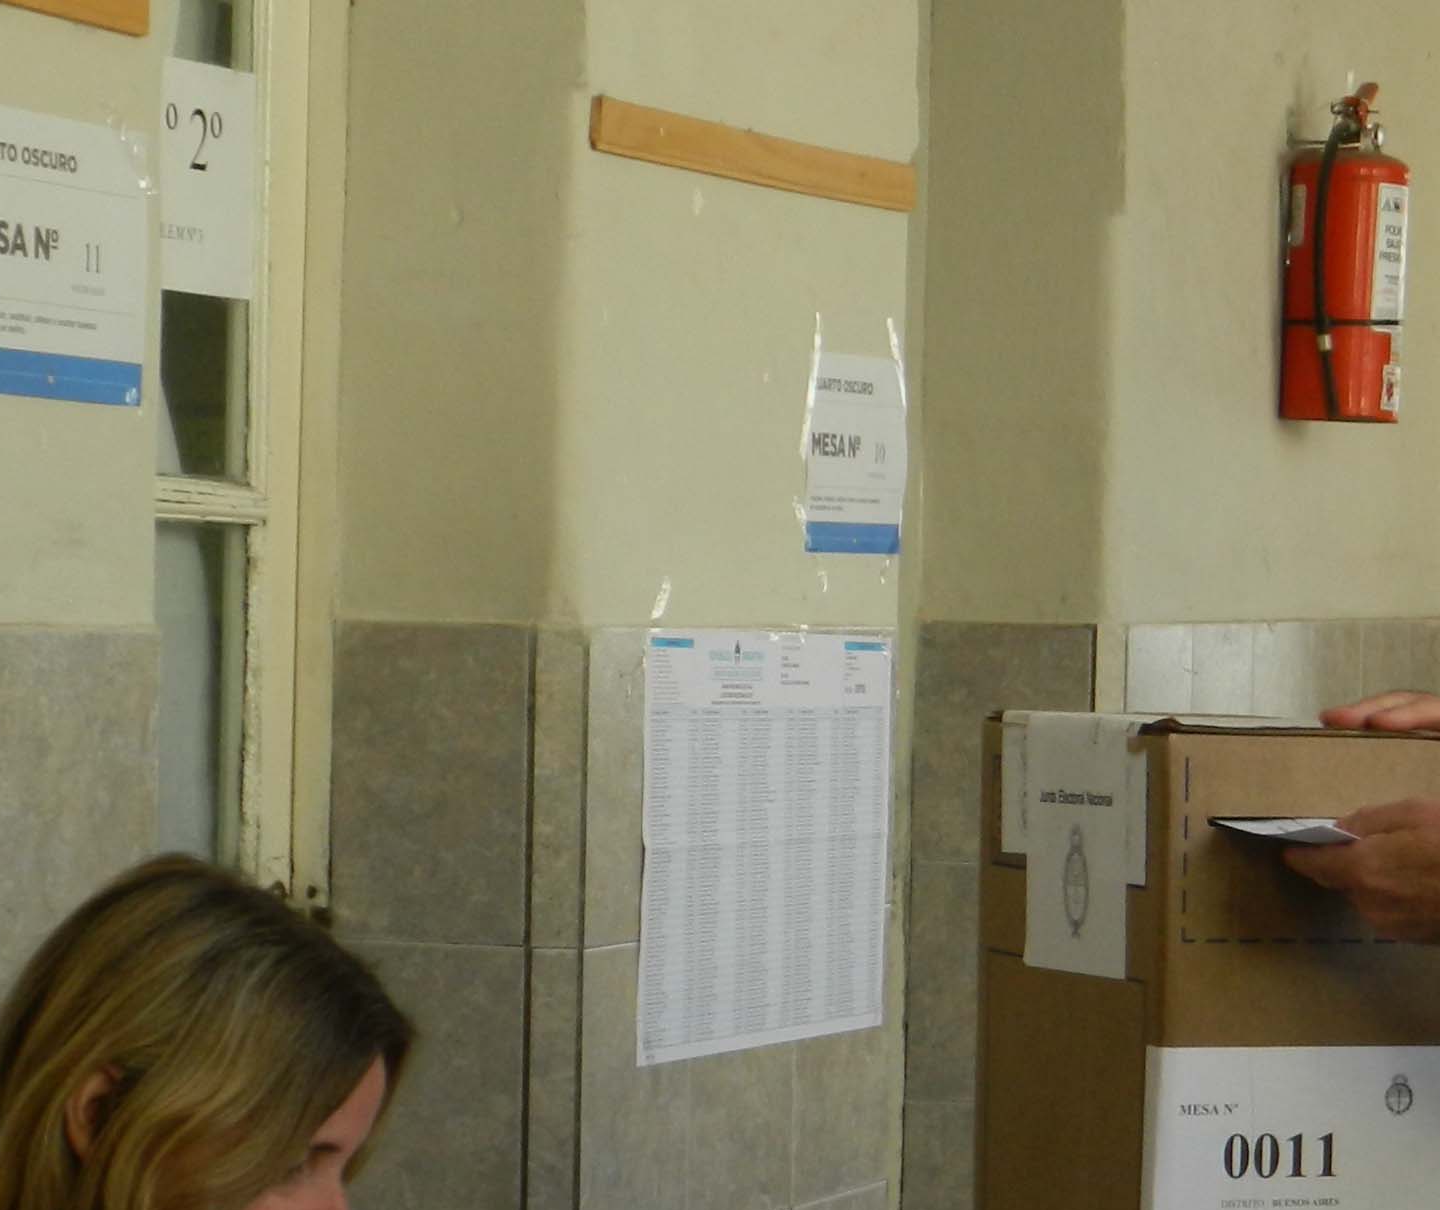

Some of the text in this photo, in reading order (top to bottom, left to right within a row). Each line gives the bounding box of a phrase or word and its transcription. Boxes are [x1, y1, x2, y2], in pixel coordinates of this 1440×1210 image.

[21, 146, 78, 175] OSCURO
[84, 241, 102, 274] 11
[816, 376, 842, 393] UARTO
[811, 431, 846, 458] MESA
[1178, 1103, 1220, 1117] MESA
[1223, 1132, 1338, 1179] 0011
[1271, 1198, 1311, 1208] BUENOS
[1312, 1197, 1341, 1207] AIRES
